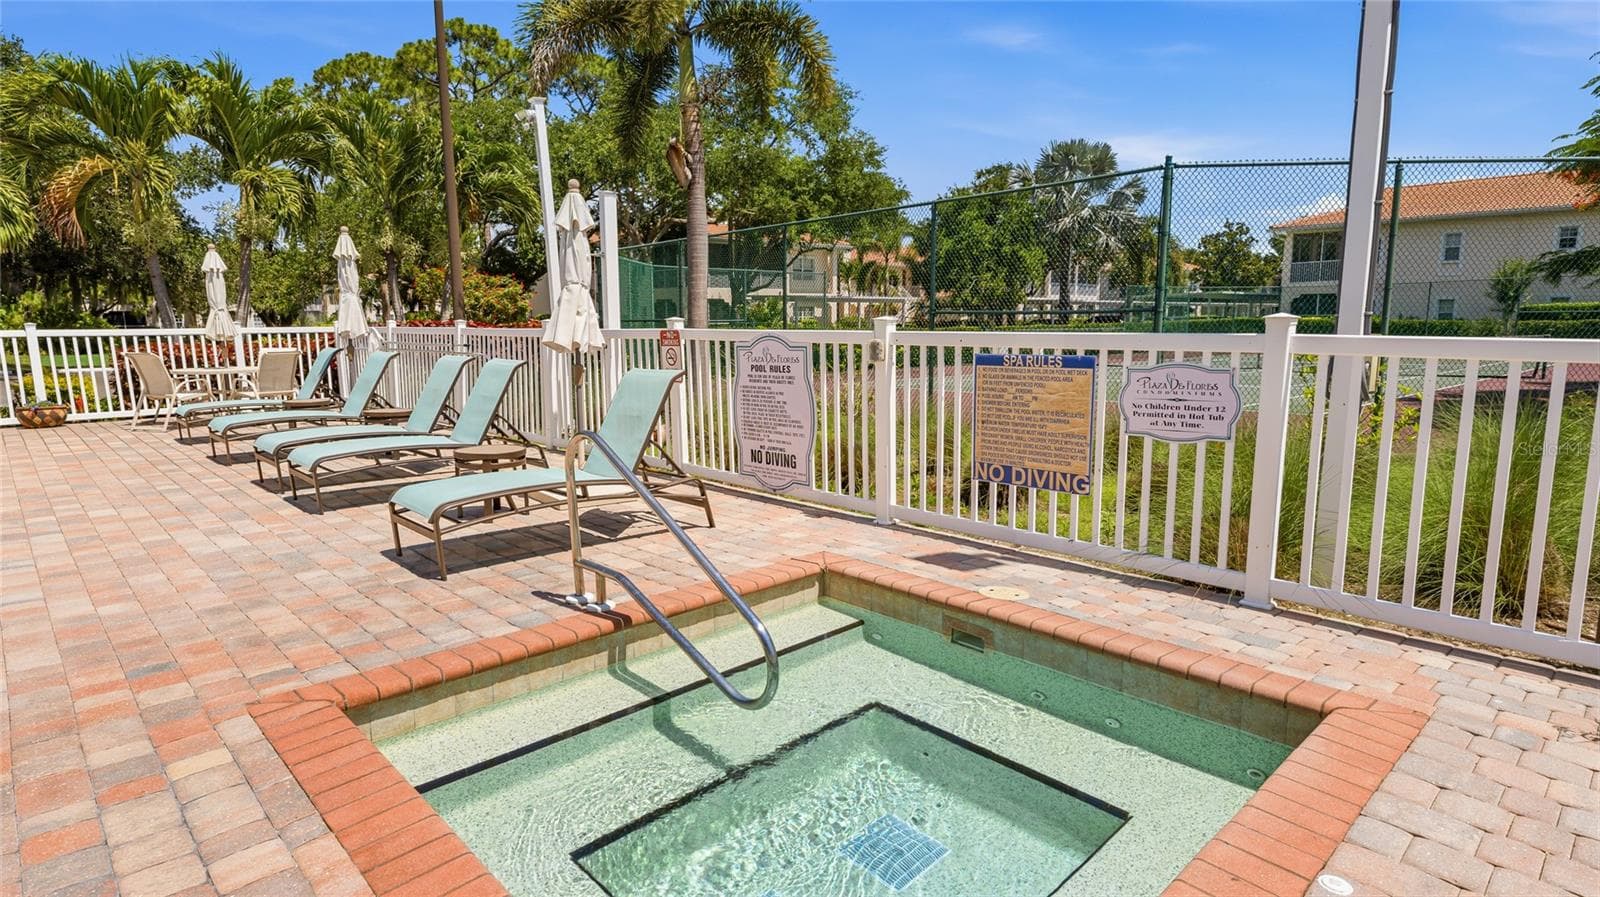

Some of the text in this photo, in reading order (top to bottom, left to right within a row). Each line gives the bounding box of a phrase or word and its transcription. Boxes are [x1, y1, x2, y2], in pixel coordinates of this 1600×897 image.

[1003, 354, 1063, 368] SPA RULES
[770, 365, 791, 373] RULES
[1133, 411, 1175, 419] Permitted
[1161, 420, 1177, 428] Any
[751, 449, 796, 469] NO DIVING
[975, 463, 1090, 494] NO DIVING
